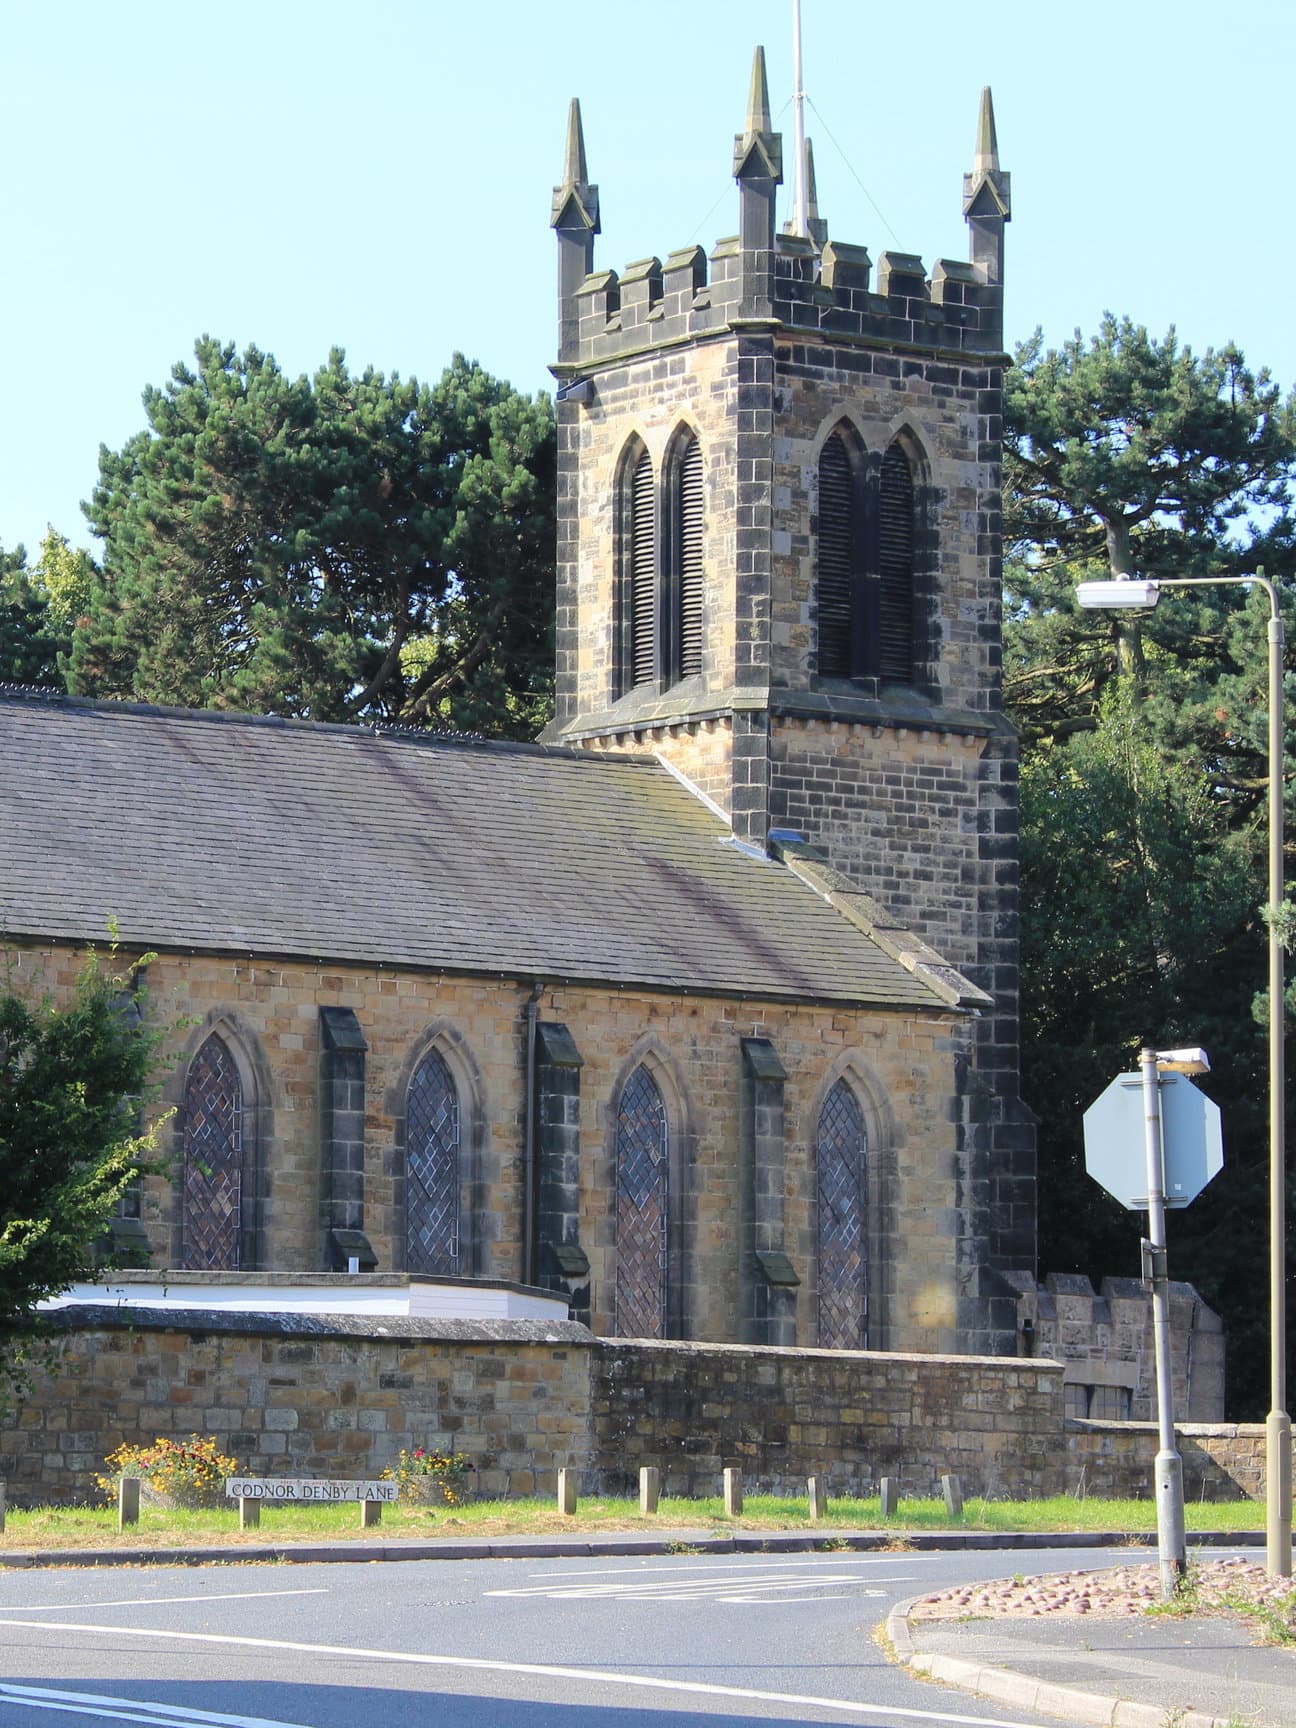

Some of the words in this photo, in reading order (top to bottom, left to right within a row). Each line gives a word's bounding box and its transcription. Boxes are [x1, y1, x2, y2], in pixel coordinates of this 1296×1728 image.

[232, 1483, 296, 1498] CODNOR
[303, 1485, 349, 1499] DENBY
[356, 1486, 394, 1500] LANE
